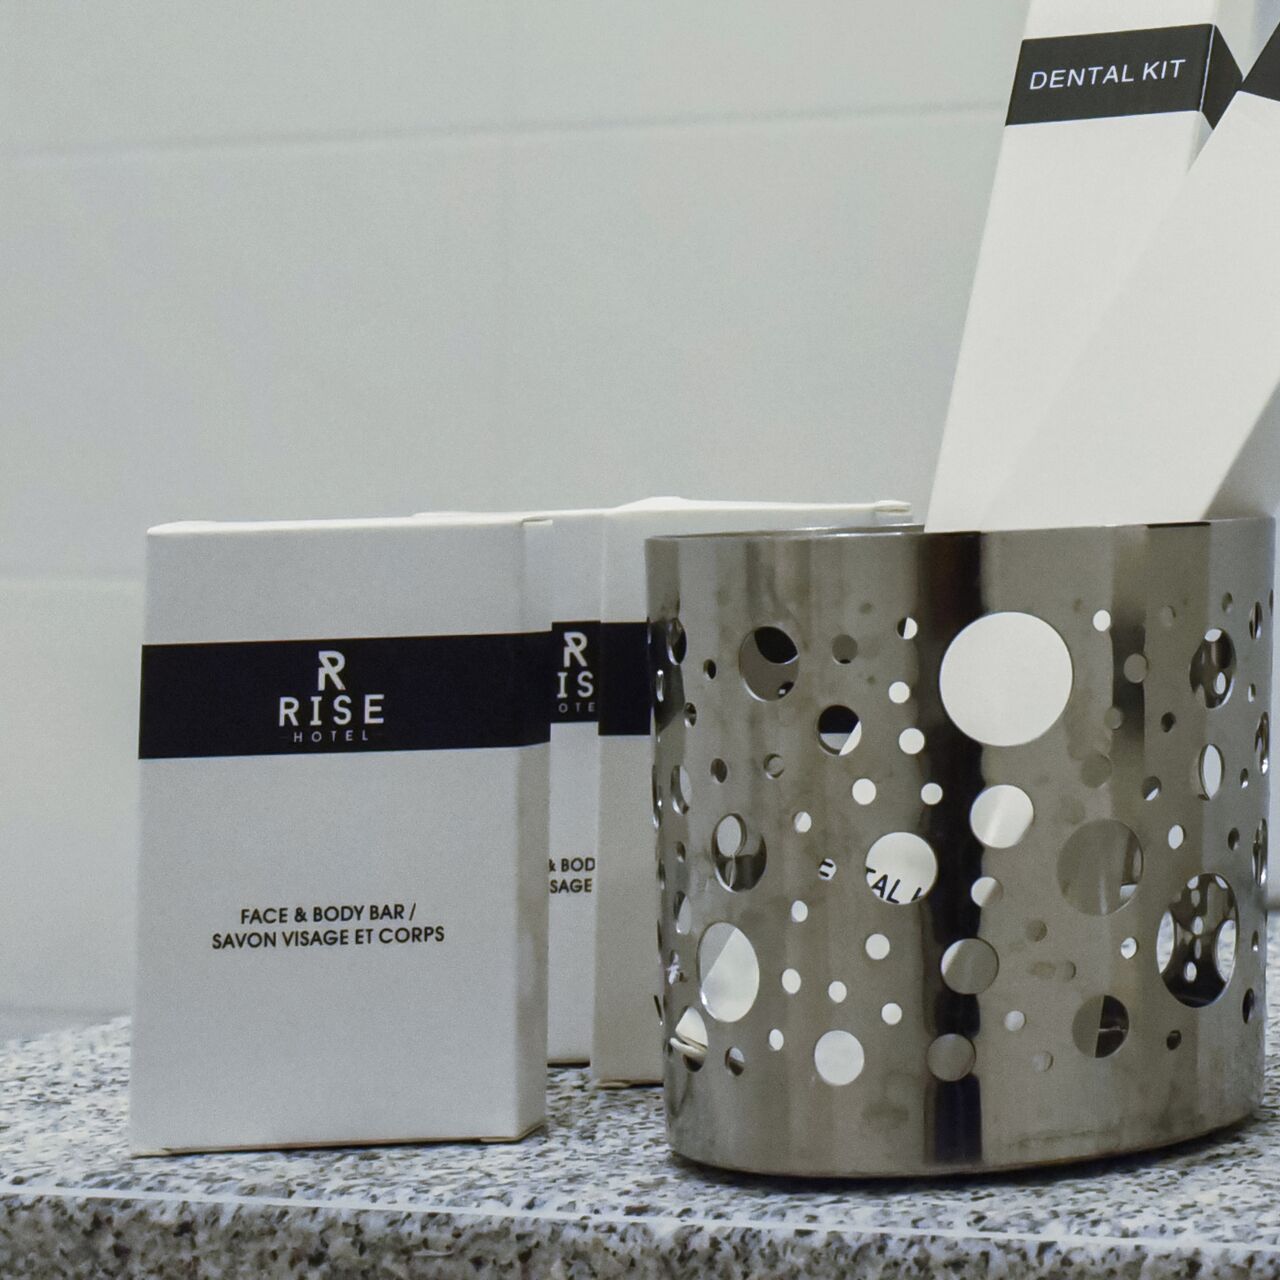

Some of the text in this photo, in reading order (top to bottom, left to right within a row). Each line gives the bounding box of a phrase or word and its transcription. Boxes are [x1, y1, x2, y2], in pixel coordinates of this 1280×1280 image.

[1029, 58, 1187, 91] DENTAL KIT
[563, 632, 588, 668] R
[317, 650, 347, 691] R
[557, 671, 594, 699] IS
[278, 694, 385, 727] RISE
[558, 702, 596, 714] OTE
[293, 729, 369, 743] HOTEL
[561, 857, 596, 872] BOD
[549, 878, 593, 894] SAGE
[240, 902, 416, 925] FACE & BODY BAR /
[212, 926, 445, 949] SAVON VISAGE ET CORPS
